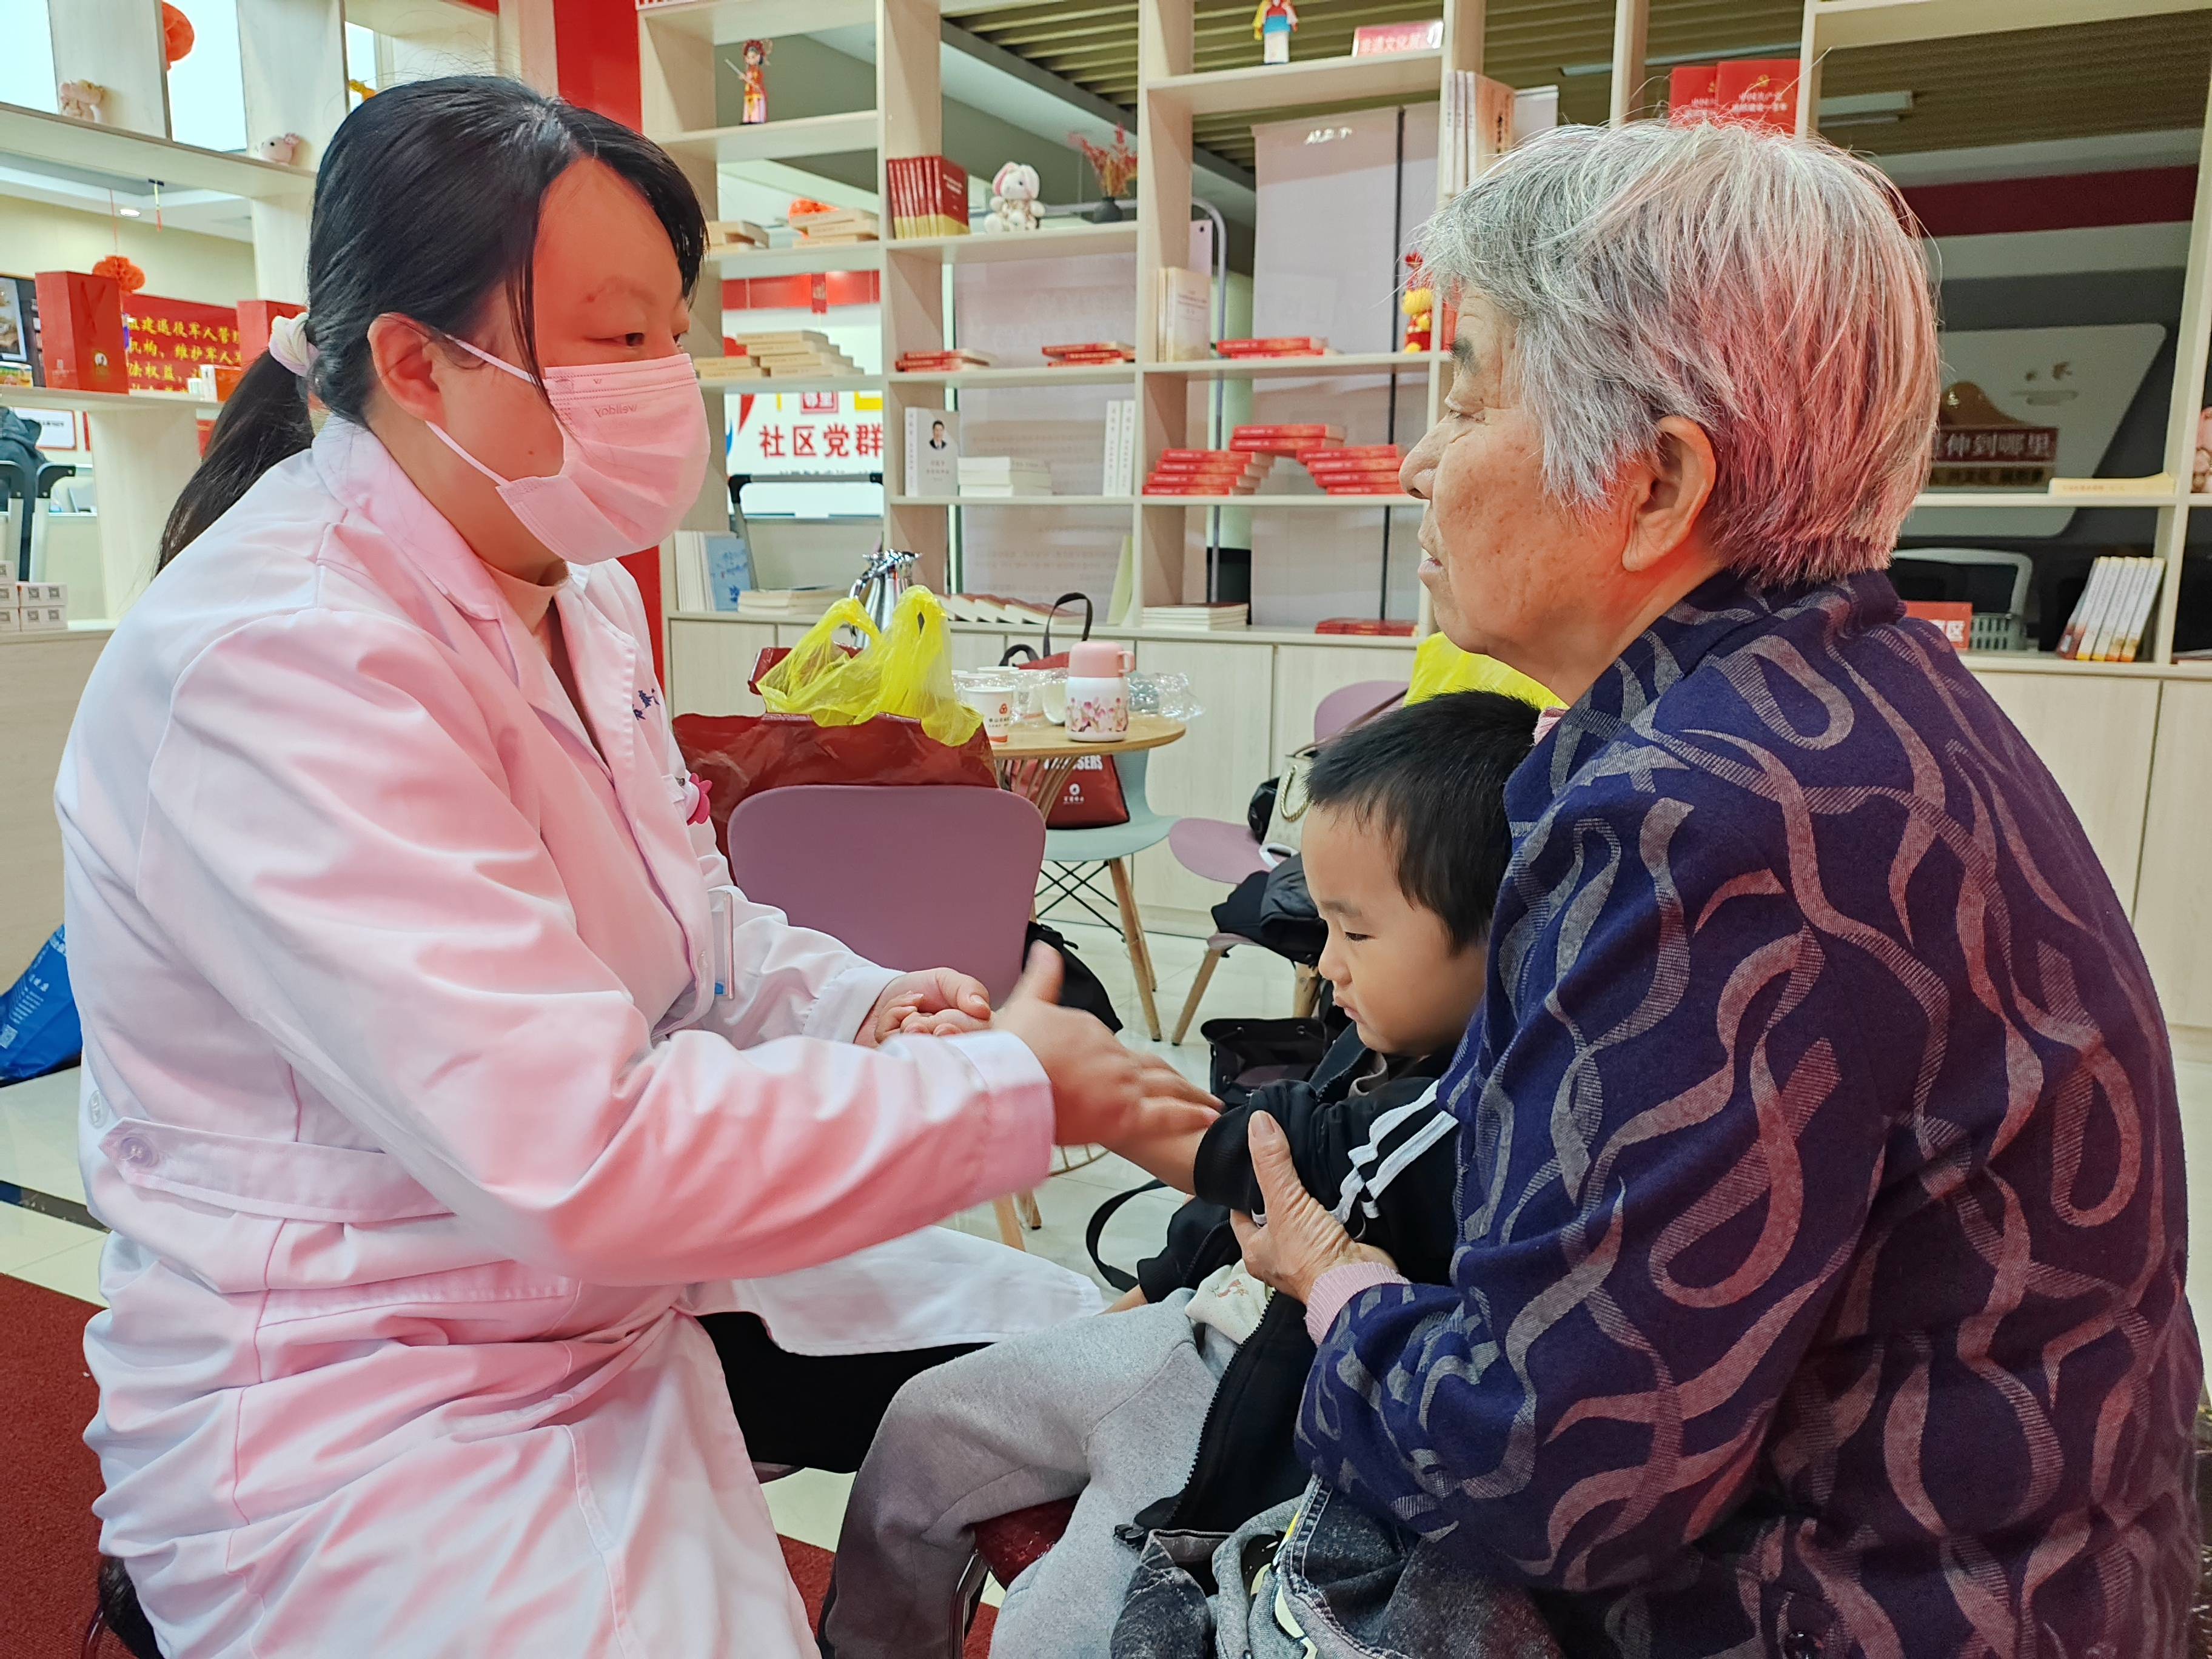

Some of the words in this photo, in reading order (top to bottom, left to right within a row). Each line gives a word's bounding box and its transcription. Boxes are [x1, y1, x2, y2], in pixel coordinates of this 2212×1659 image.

[760, 423, 883, 458] 社区党群
[1936, 432, 2050, 458] 伸到哪里
